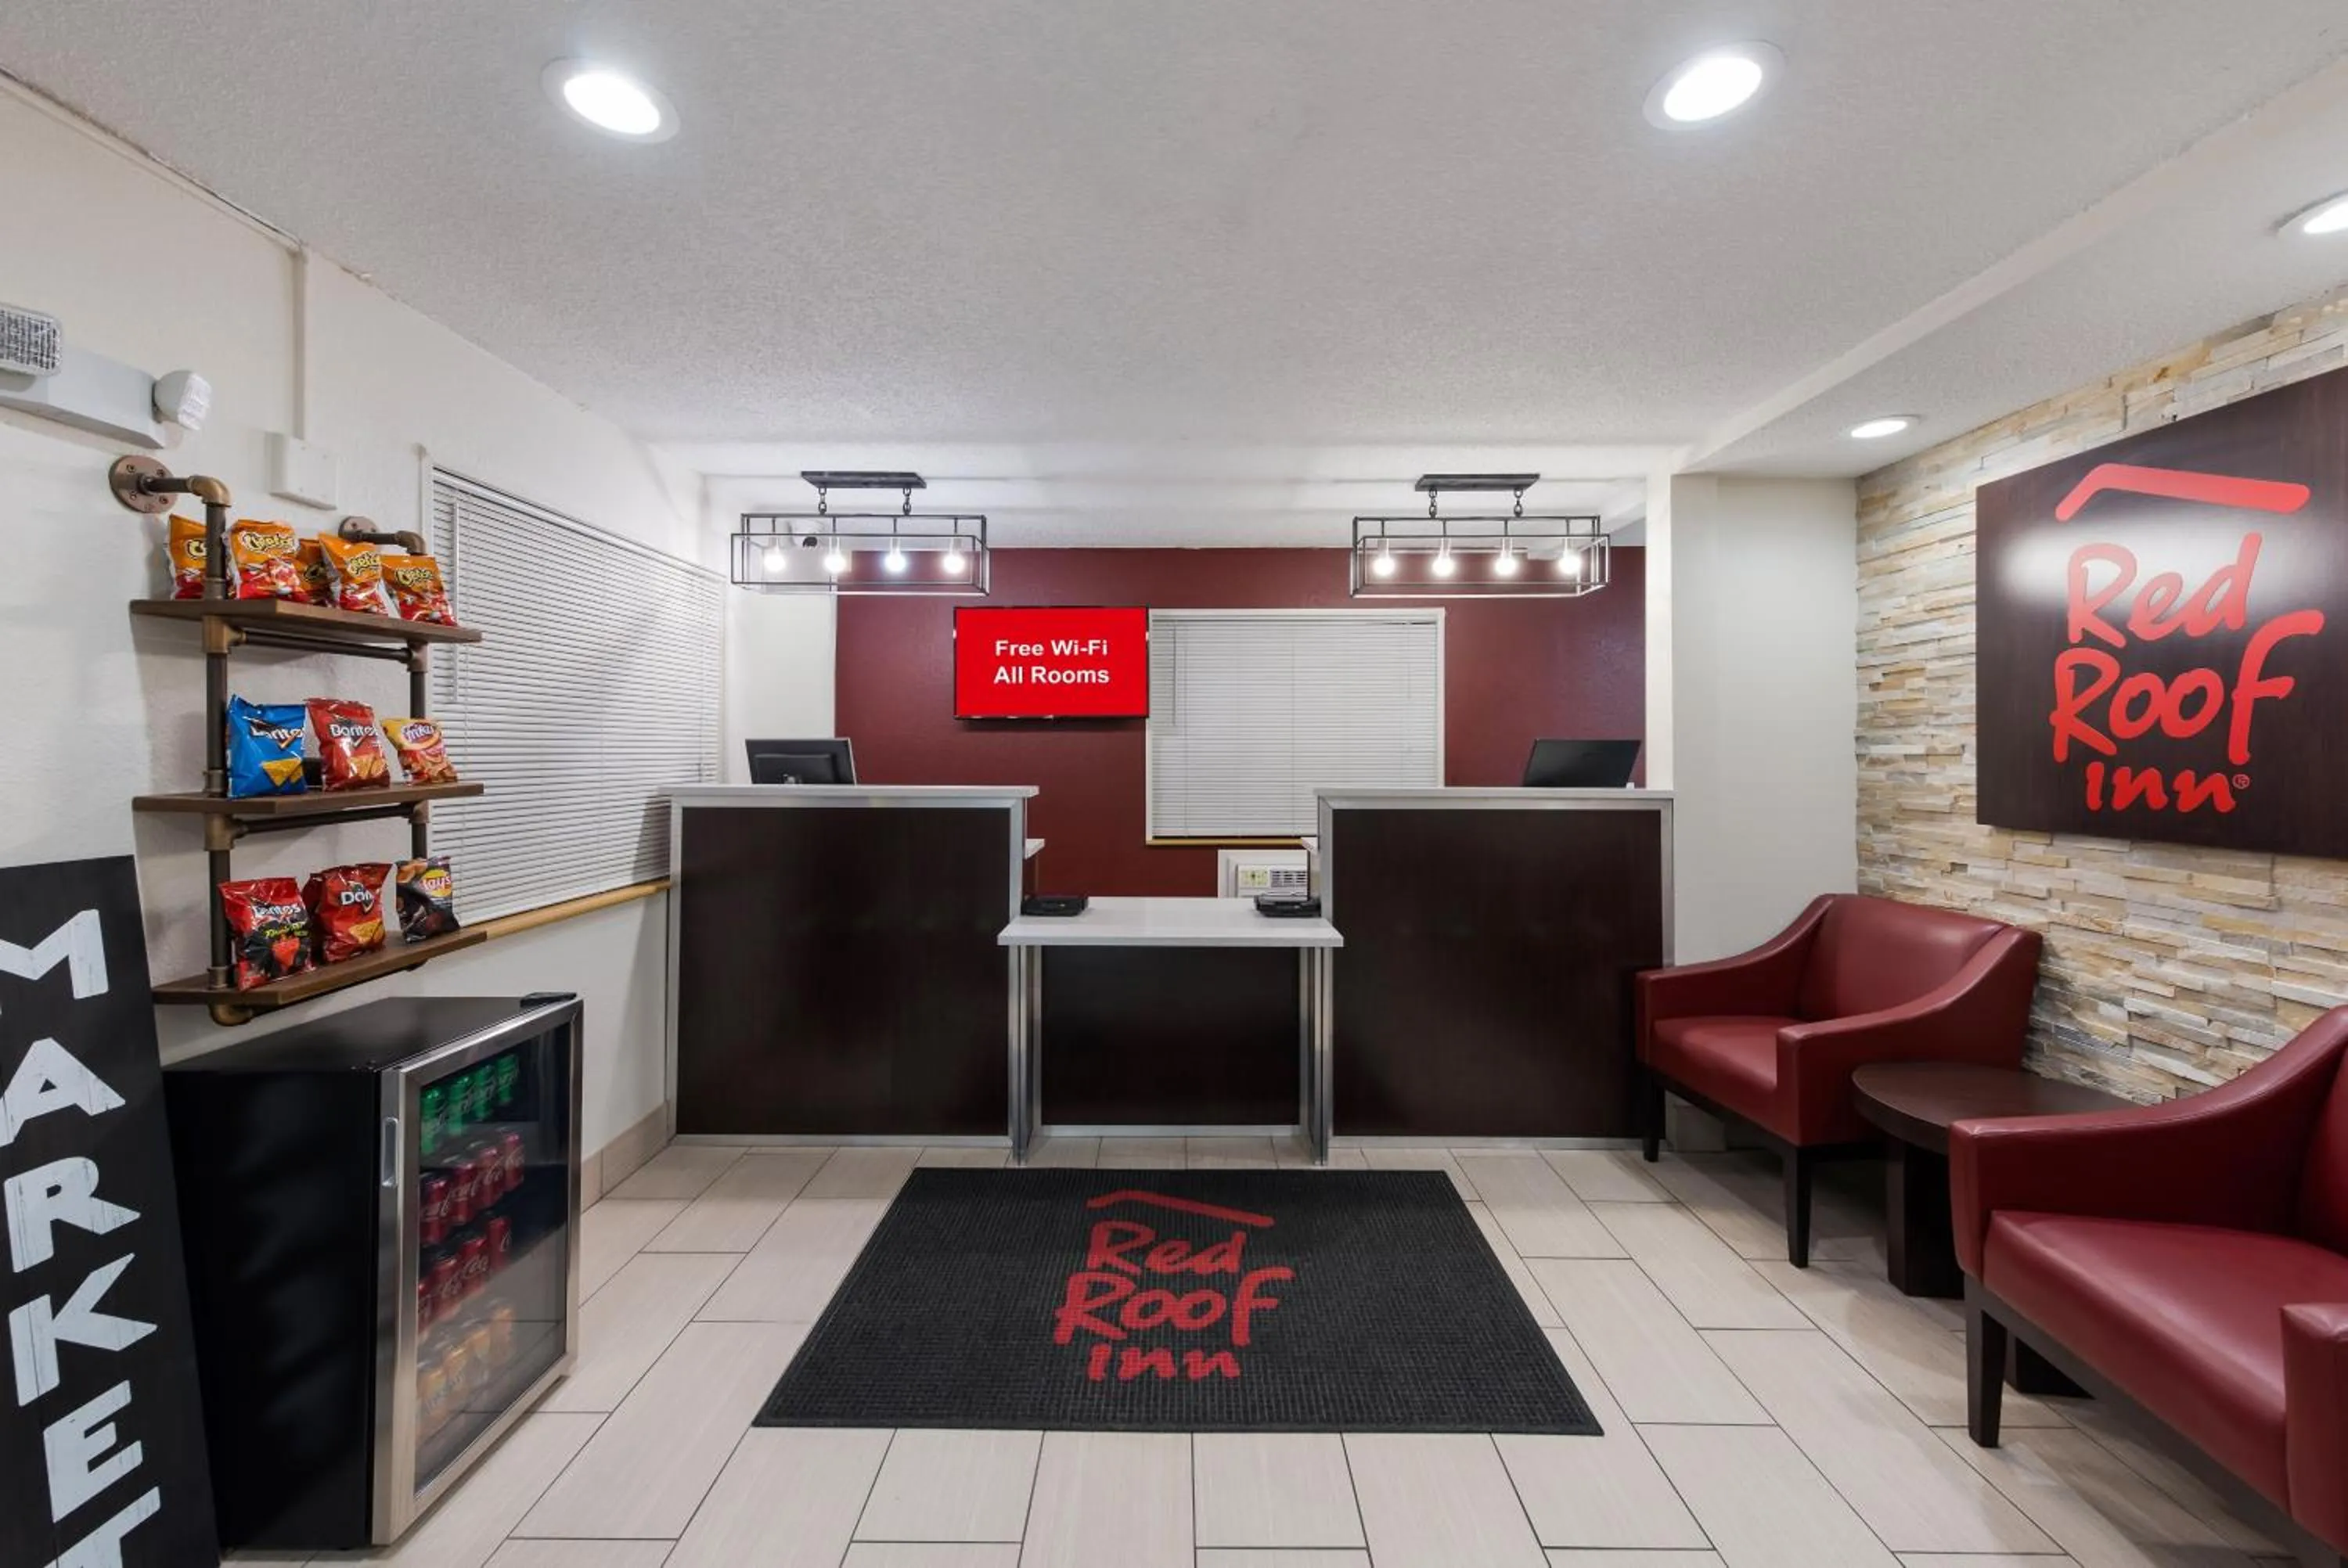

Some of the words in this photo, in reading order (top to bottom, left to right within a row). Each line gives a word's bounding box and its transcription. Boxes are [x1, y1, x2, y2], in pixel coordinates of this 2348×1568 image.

[2067, 532, 2263, 649] Red
[993, 666, 1024, 685] All
[1031, 666, 1110, 685] Rooms
[994, 639, 1045, 657] Free
[1051, 639, 1108, 657] Wi-Fi
[2049, 610, 2325, 765] Roof
[1086, 1220, 1247, 1277] Red
[1053, 1265, 1296, 1347] Roof
